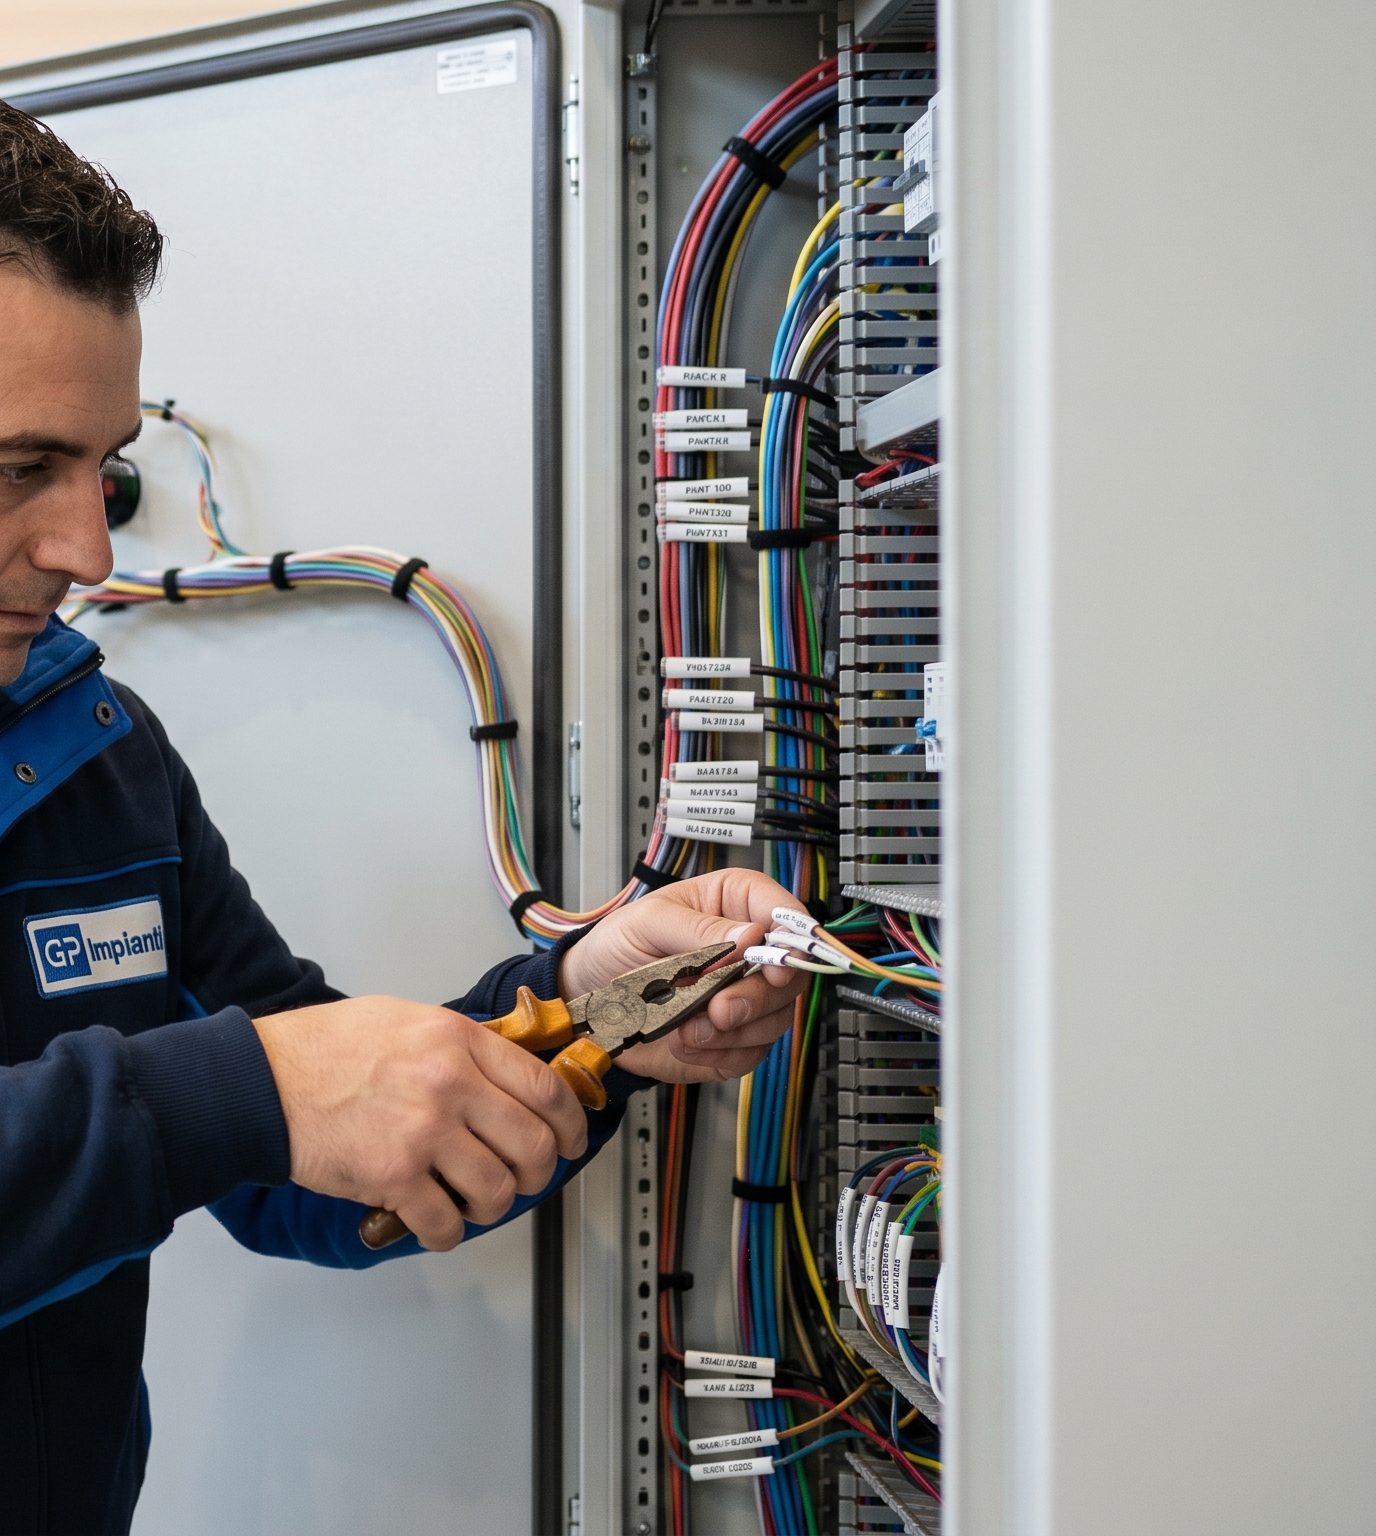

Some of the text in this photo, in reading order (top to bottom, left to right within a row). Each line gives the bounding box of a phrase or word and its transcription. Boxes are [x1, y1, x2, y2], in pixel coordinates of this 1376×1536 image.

[714, 483, 732, 493] 100
[44, 925, 164, 968] GP Impianti
